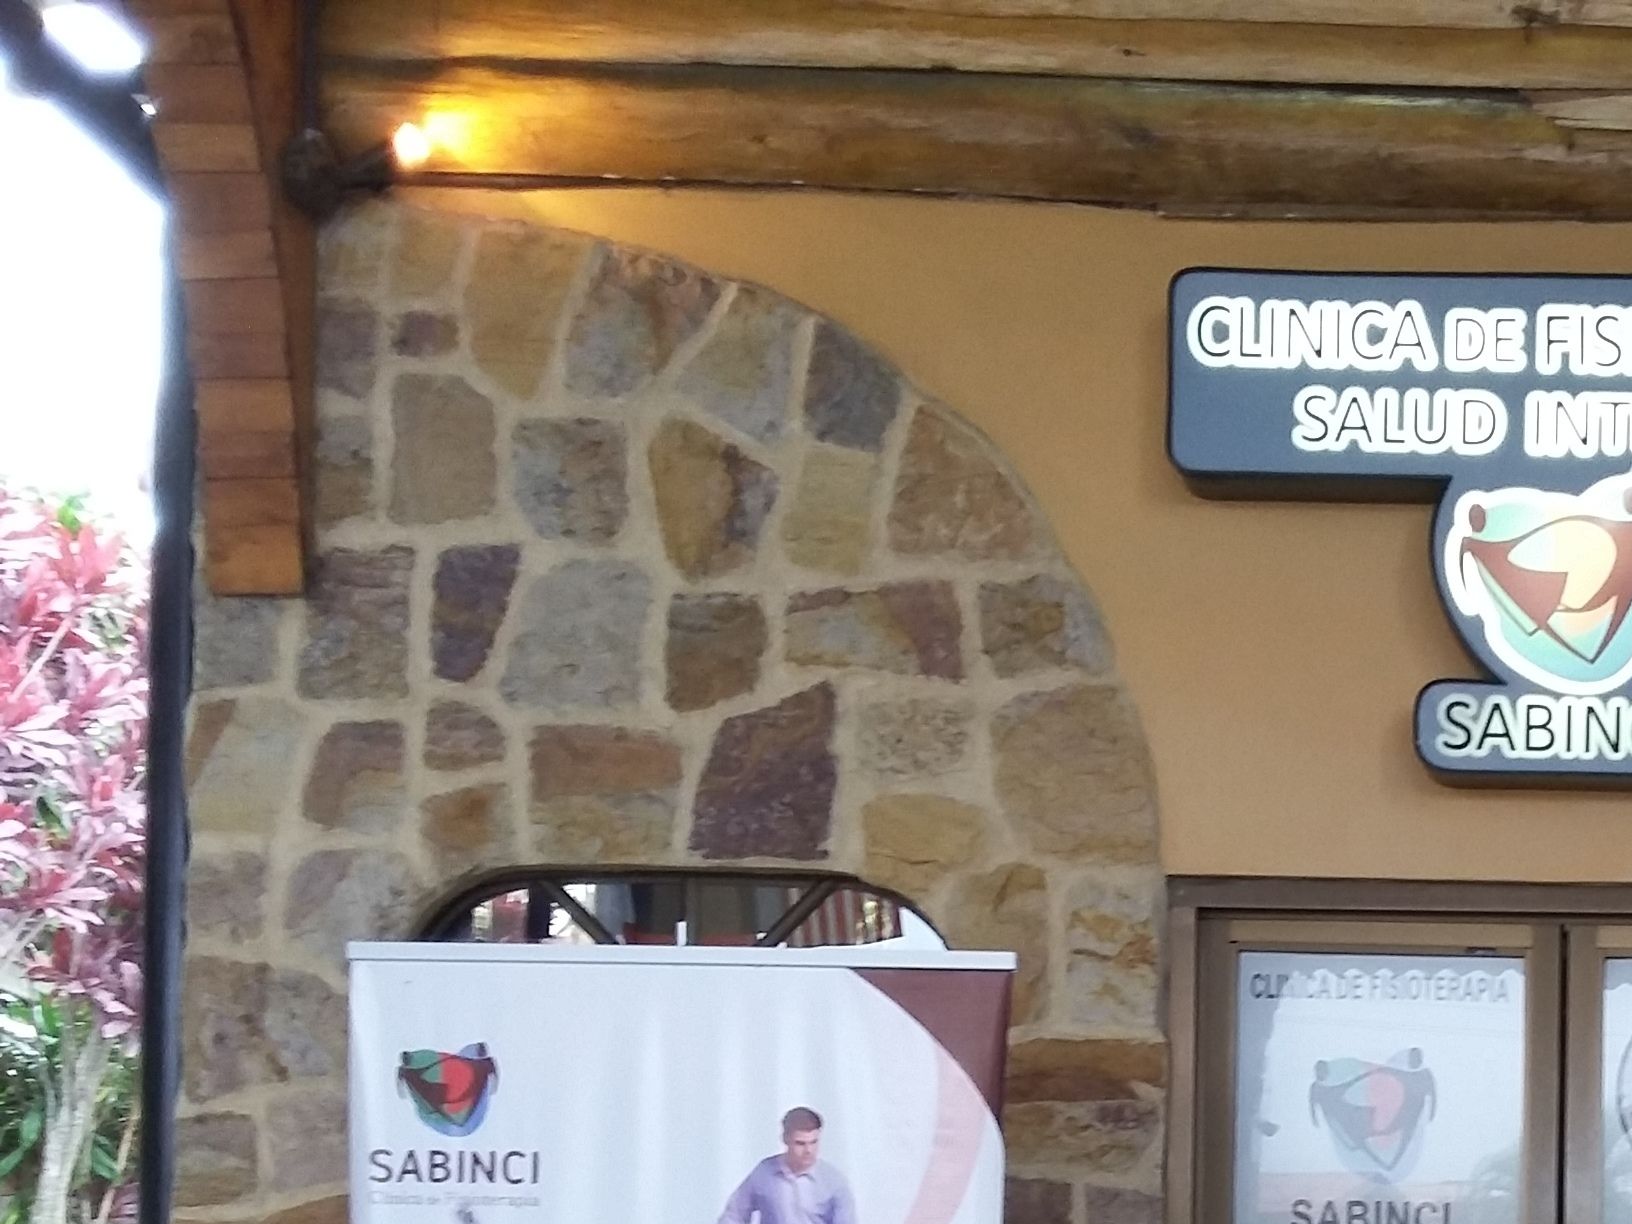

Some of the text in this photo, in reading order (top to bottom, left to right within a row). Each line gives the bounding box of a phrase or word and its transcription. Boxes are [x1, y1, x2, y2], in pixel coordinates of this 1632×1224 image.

[1193, 302, 1430, 366] CLINICA
[1448, 308, 1522, 367] DE
[1297, 391, 1503, 448] SALUD
[368, 1149, 540, 1184] SABINCI
